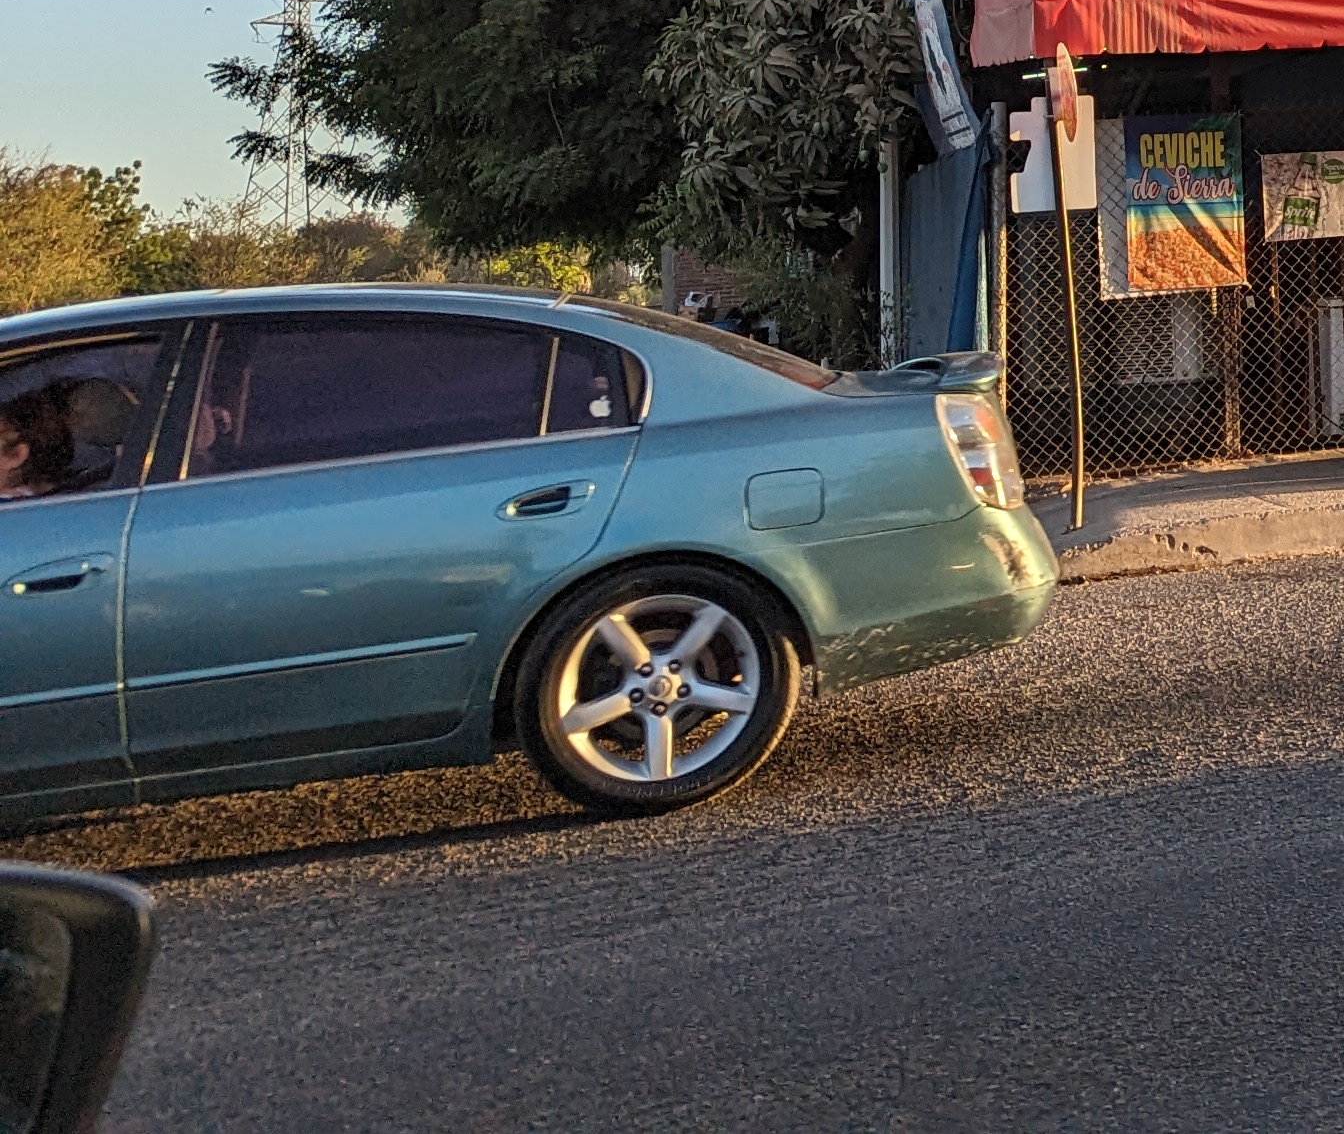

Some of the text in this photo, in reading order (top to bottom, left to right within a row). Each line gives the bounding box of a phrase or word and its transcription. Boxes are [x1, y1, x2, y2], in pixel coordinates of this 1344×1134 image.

[1139, 131, 1226, 169] CEVICHE
[1132, 164, 1236, 204] de Sierra
